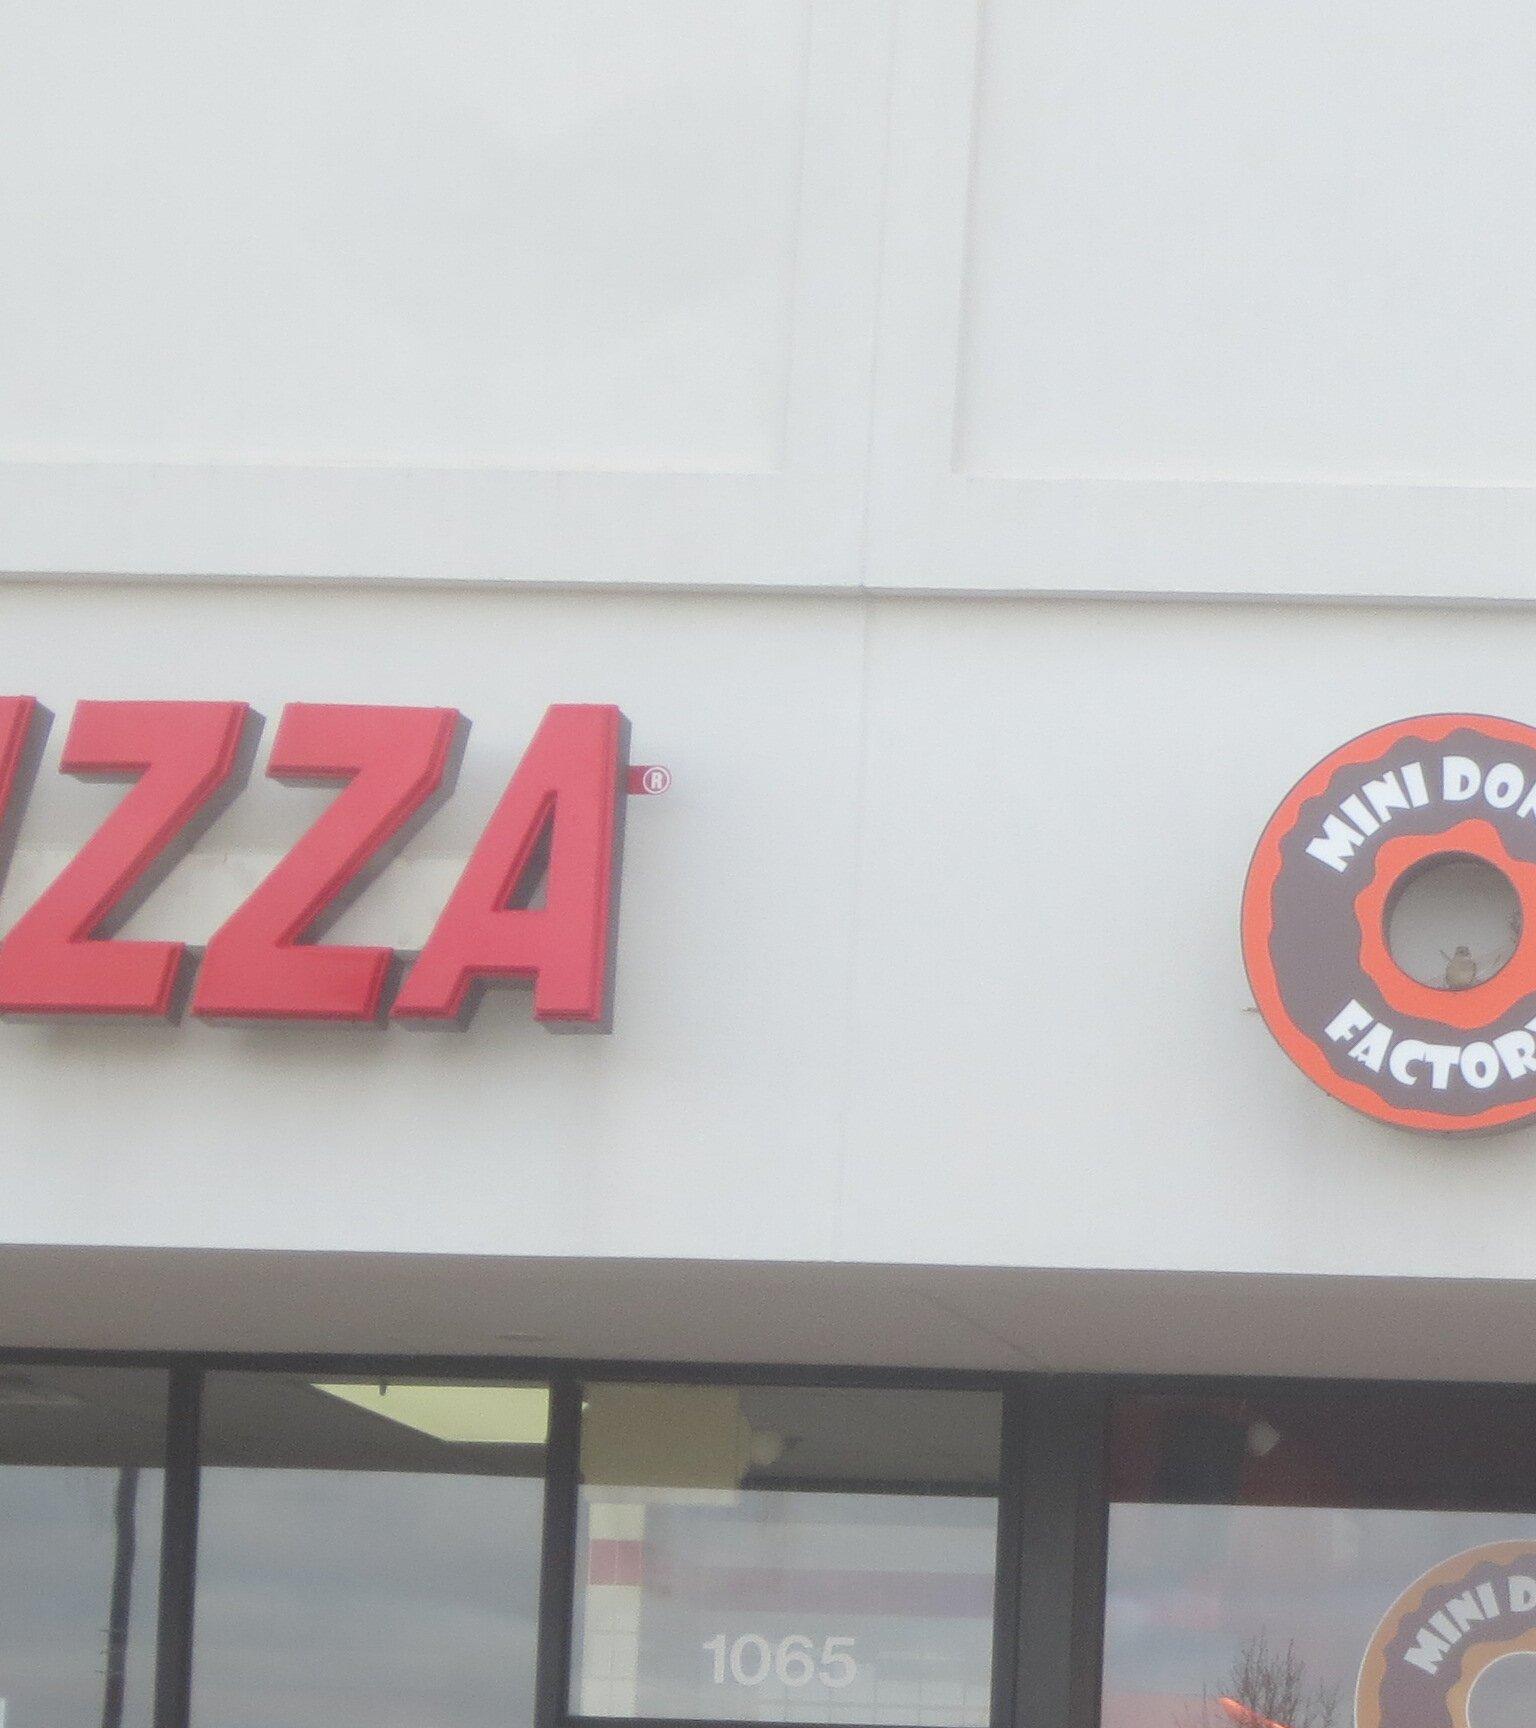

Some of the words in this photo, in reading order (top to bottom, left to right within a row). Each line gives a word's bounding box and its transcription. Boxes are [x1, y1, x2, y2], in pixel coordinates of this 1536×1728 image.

[0, 695, 630, 1033] ZZA
[1305, 761, 1429, 873] MINI
[702, 1632, 858, 1689] 1065
[1403, 1581, 1500, 1676] MINI
